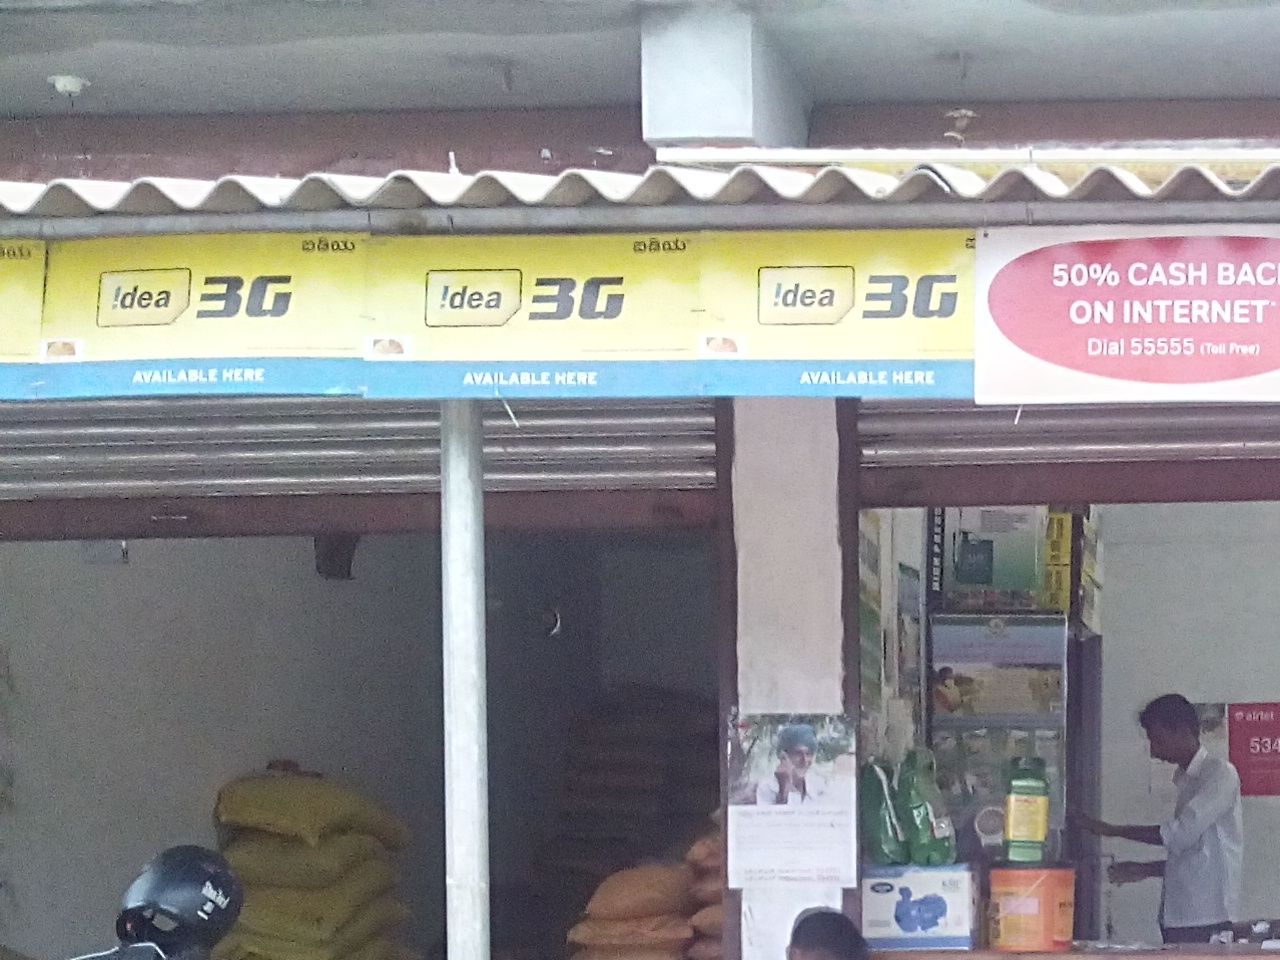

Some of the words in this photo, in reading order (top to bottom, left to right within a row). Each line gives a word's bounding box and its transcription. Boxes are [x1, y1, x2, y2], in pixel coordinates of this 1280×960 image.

[1052, 262, 1120, 288] 50%
[1127, 262, 1208, 287] CASH
[196, 275, 292, 318] 3G
[528, 277, 625, 321] 3G
[862, 274, 959, 319] 3G
[1069, 299, 1117, 325] ON
[1087, 338, 1125, 357] Dial
[1130, 337, 1195, 356] 55555
[1200, 342, 1227, 355] (Toll
[1229, 341, 1260, 355] Free)
[132, 369, 218, 384] AVAILABLE
[222, 367, 265, 383] HERE
[463, 371, 550, 385] AVAILABLE
[555, 371, 598, 385] HERE
[800, 371, 888, 385] AVAILABLE
[892, 371, 935, 385] HERE
